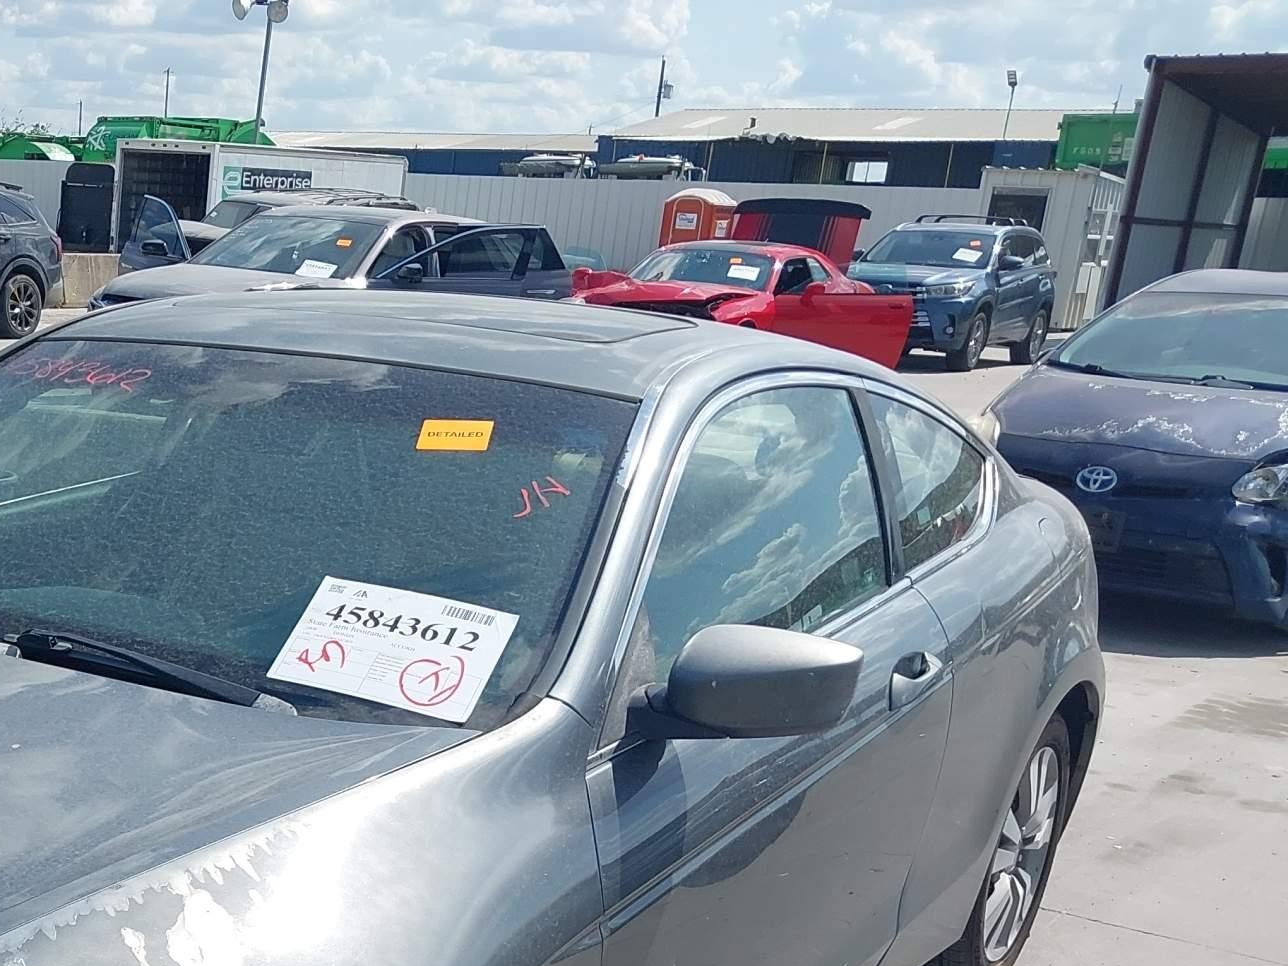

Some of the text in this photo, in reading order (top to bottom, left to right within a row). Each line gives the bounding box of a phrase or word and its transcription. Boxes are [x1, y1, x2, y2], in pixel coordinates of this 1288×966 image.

[242, 171, 311, 192] Enterprise
[325, 603, 481, 652] 45843612
[328, 623, 349, 632] Farm
[350, 625, 389, 639] Insurance
